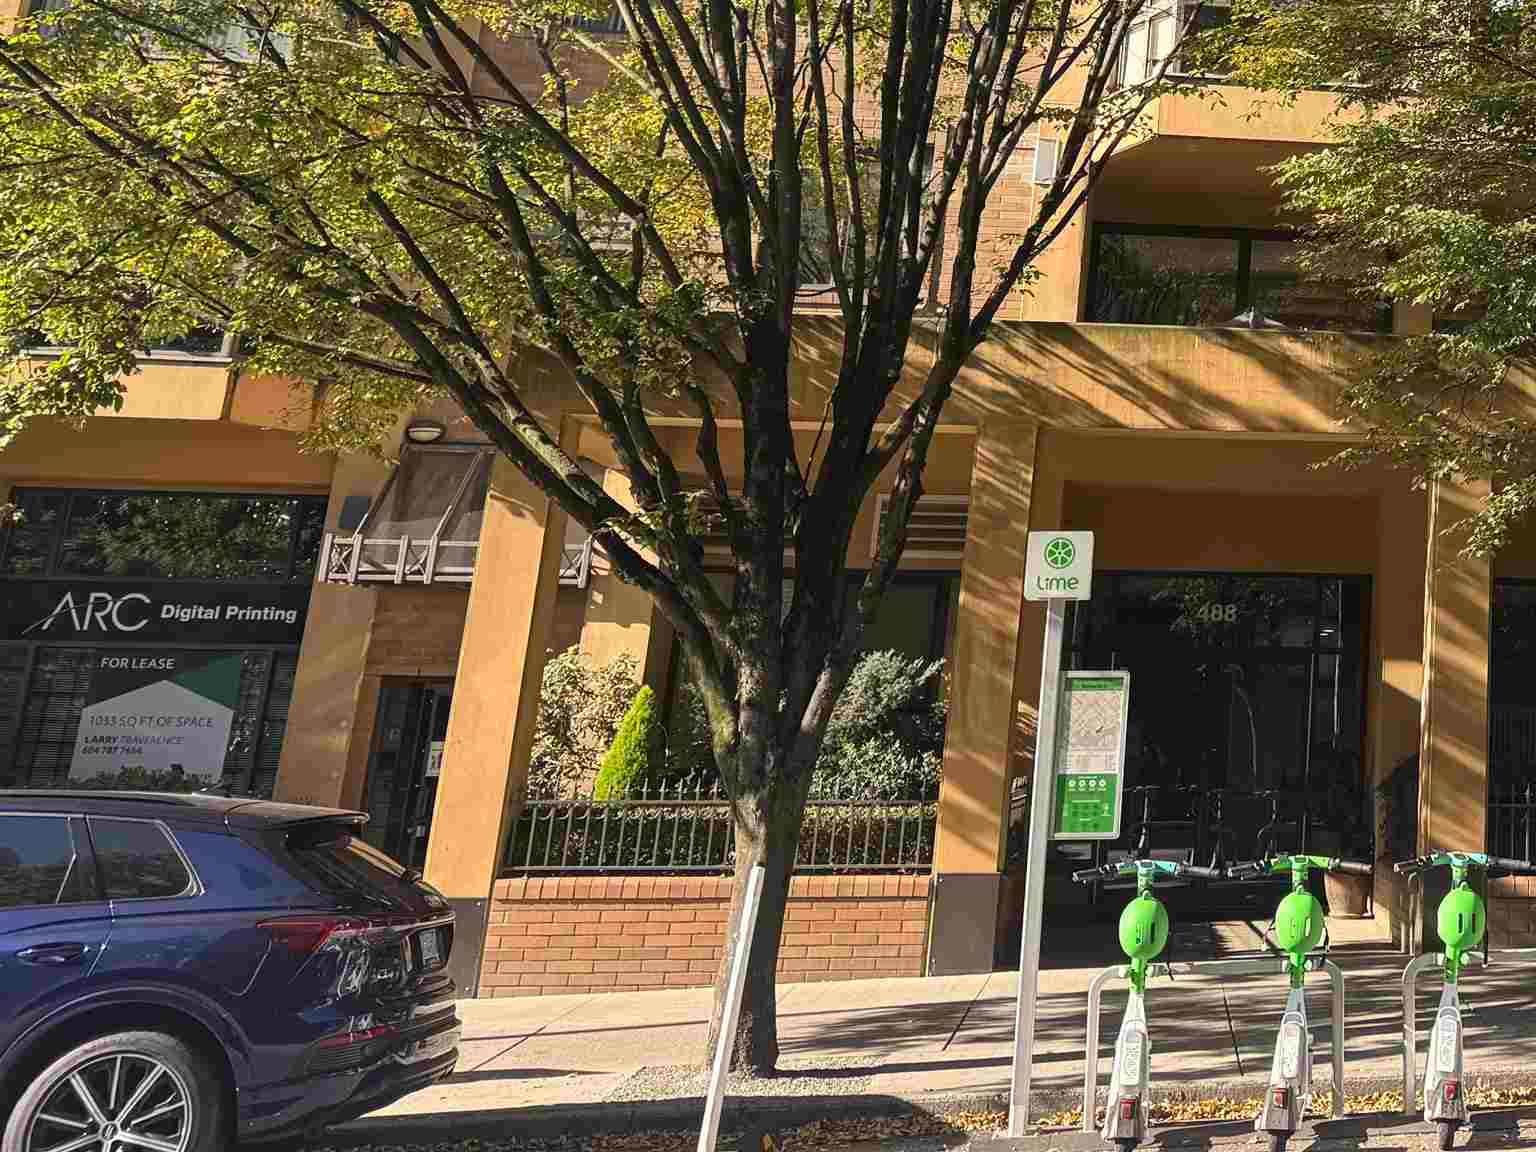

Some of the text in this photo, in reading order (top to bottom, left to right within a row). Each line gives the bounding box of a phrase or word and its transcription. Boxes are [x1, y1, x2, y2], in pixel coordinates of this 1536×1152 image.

[1036, 576, 1079, 591] Lime
[40, 591, 297, 631] ARC Digital Printing
[1196, 602, 1237, 622] 488
[101, 657, 176, 669] FOR LEASE
[119, 715, 137, 729] SQ
[139, 716, 153, 728] FT
[156, 716, 175, 728] OF
[176, 716, 214, 728] SPACE
